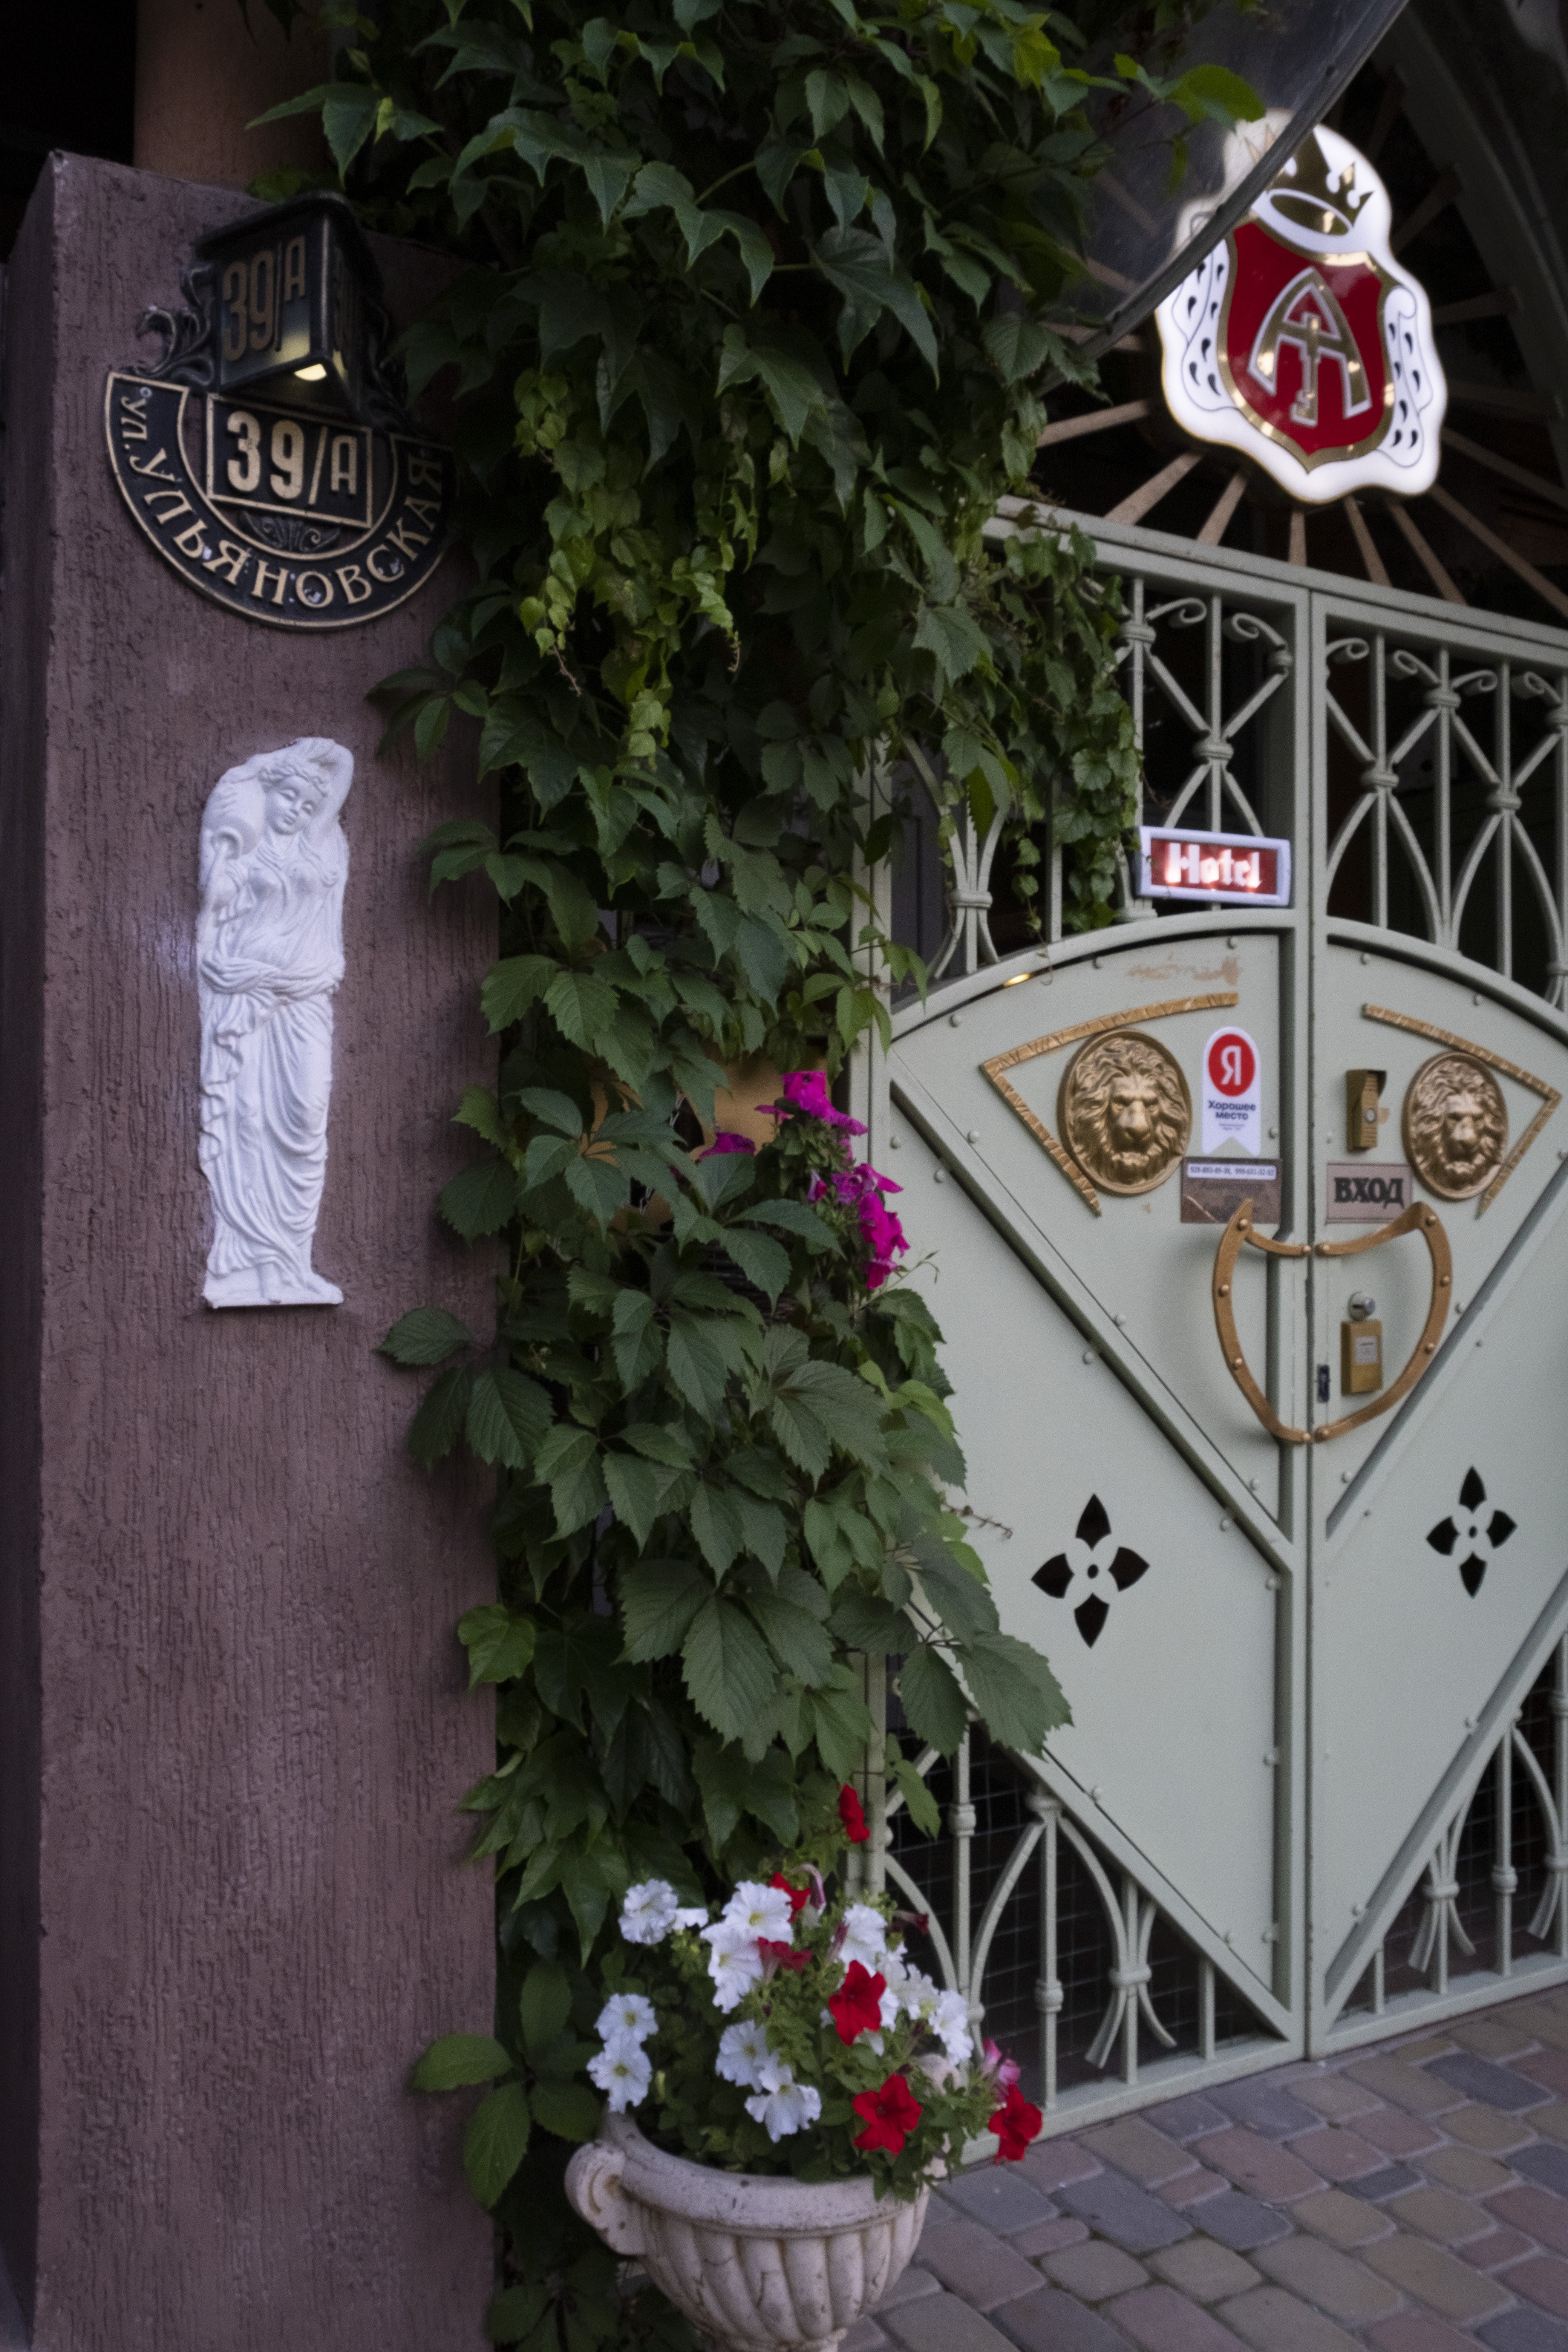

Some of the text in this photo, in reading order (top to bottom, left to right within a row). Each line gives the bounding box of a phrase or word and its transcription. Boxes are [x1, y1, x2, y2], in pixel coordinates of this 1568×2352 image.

[222, 235, 306, 362] 39/А
[226, 410, 358, 506] 39/А
[120, 395, 443, 608] ул. УЛЬЯНОВСКАЯ
[1165, 842, 1262, 889] Hotel
[1220, 1045, 1242, 1086] Я
[1208, 1100, 1256, 1112] Хорошее
[1216, 1112, 1249, 1121] место
[1334, 1176, 1406, 1209] ВХОД
